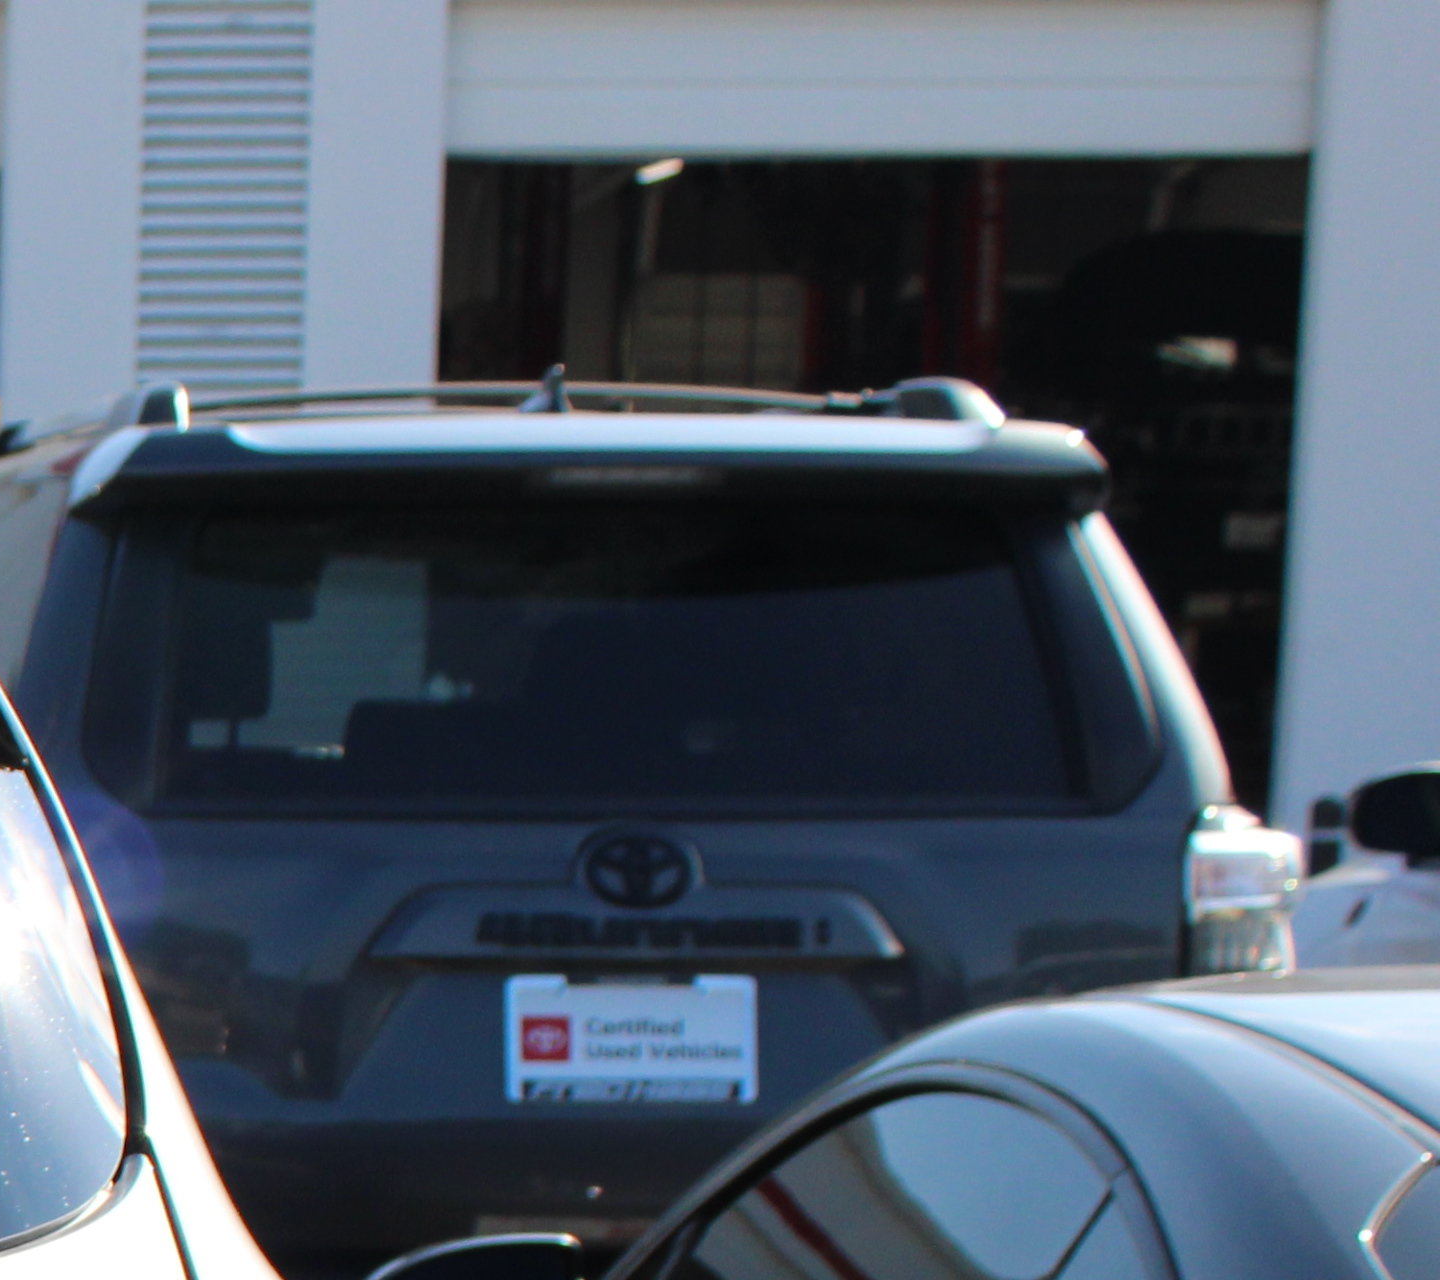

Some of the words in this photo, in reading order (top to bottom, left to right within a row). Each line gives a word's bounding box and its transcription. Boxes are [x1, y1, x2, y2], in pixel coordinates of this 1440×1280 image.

[585, 1017, 685, 1035] Certified
[586, 1042, 643, 1059] Used
[651, 1042, 743, 1059] Vehicles
